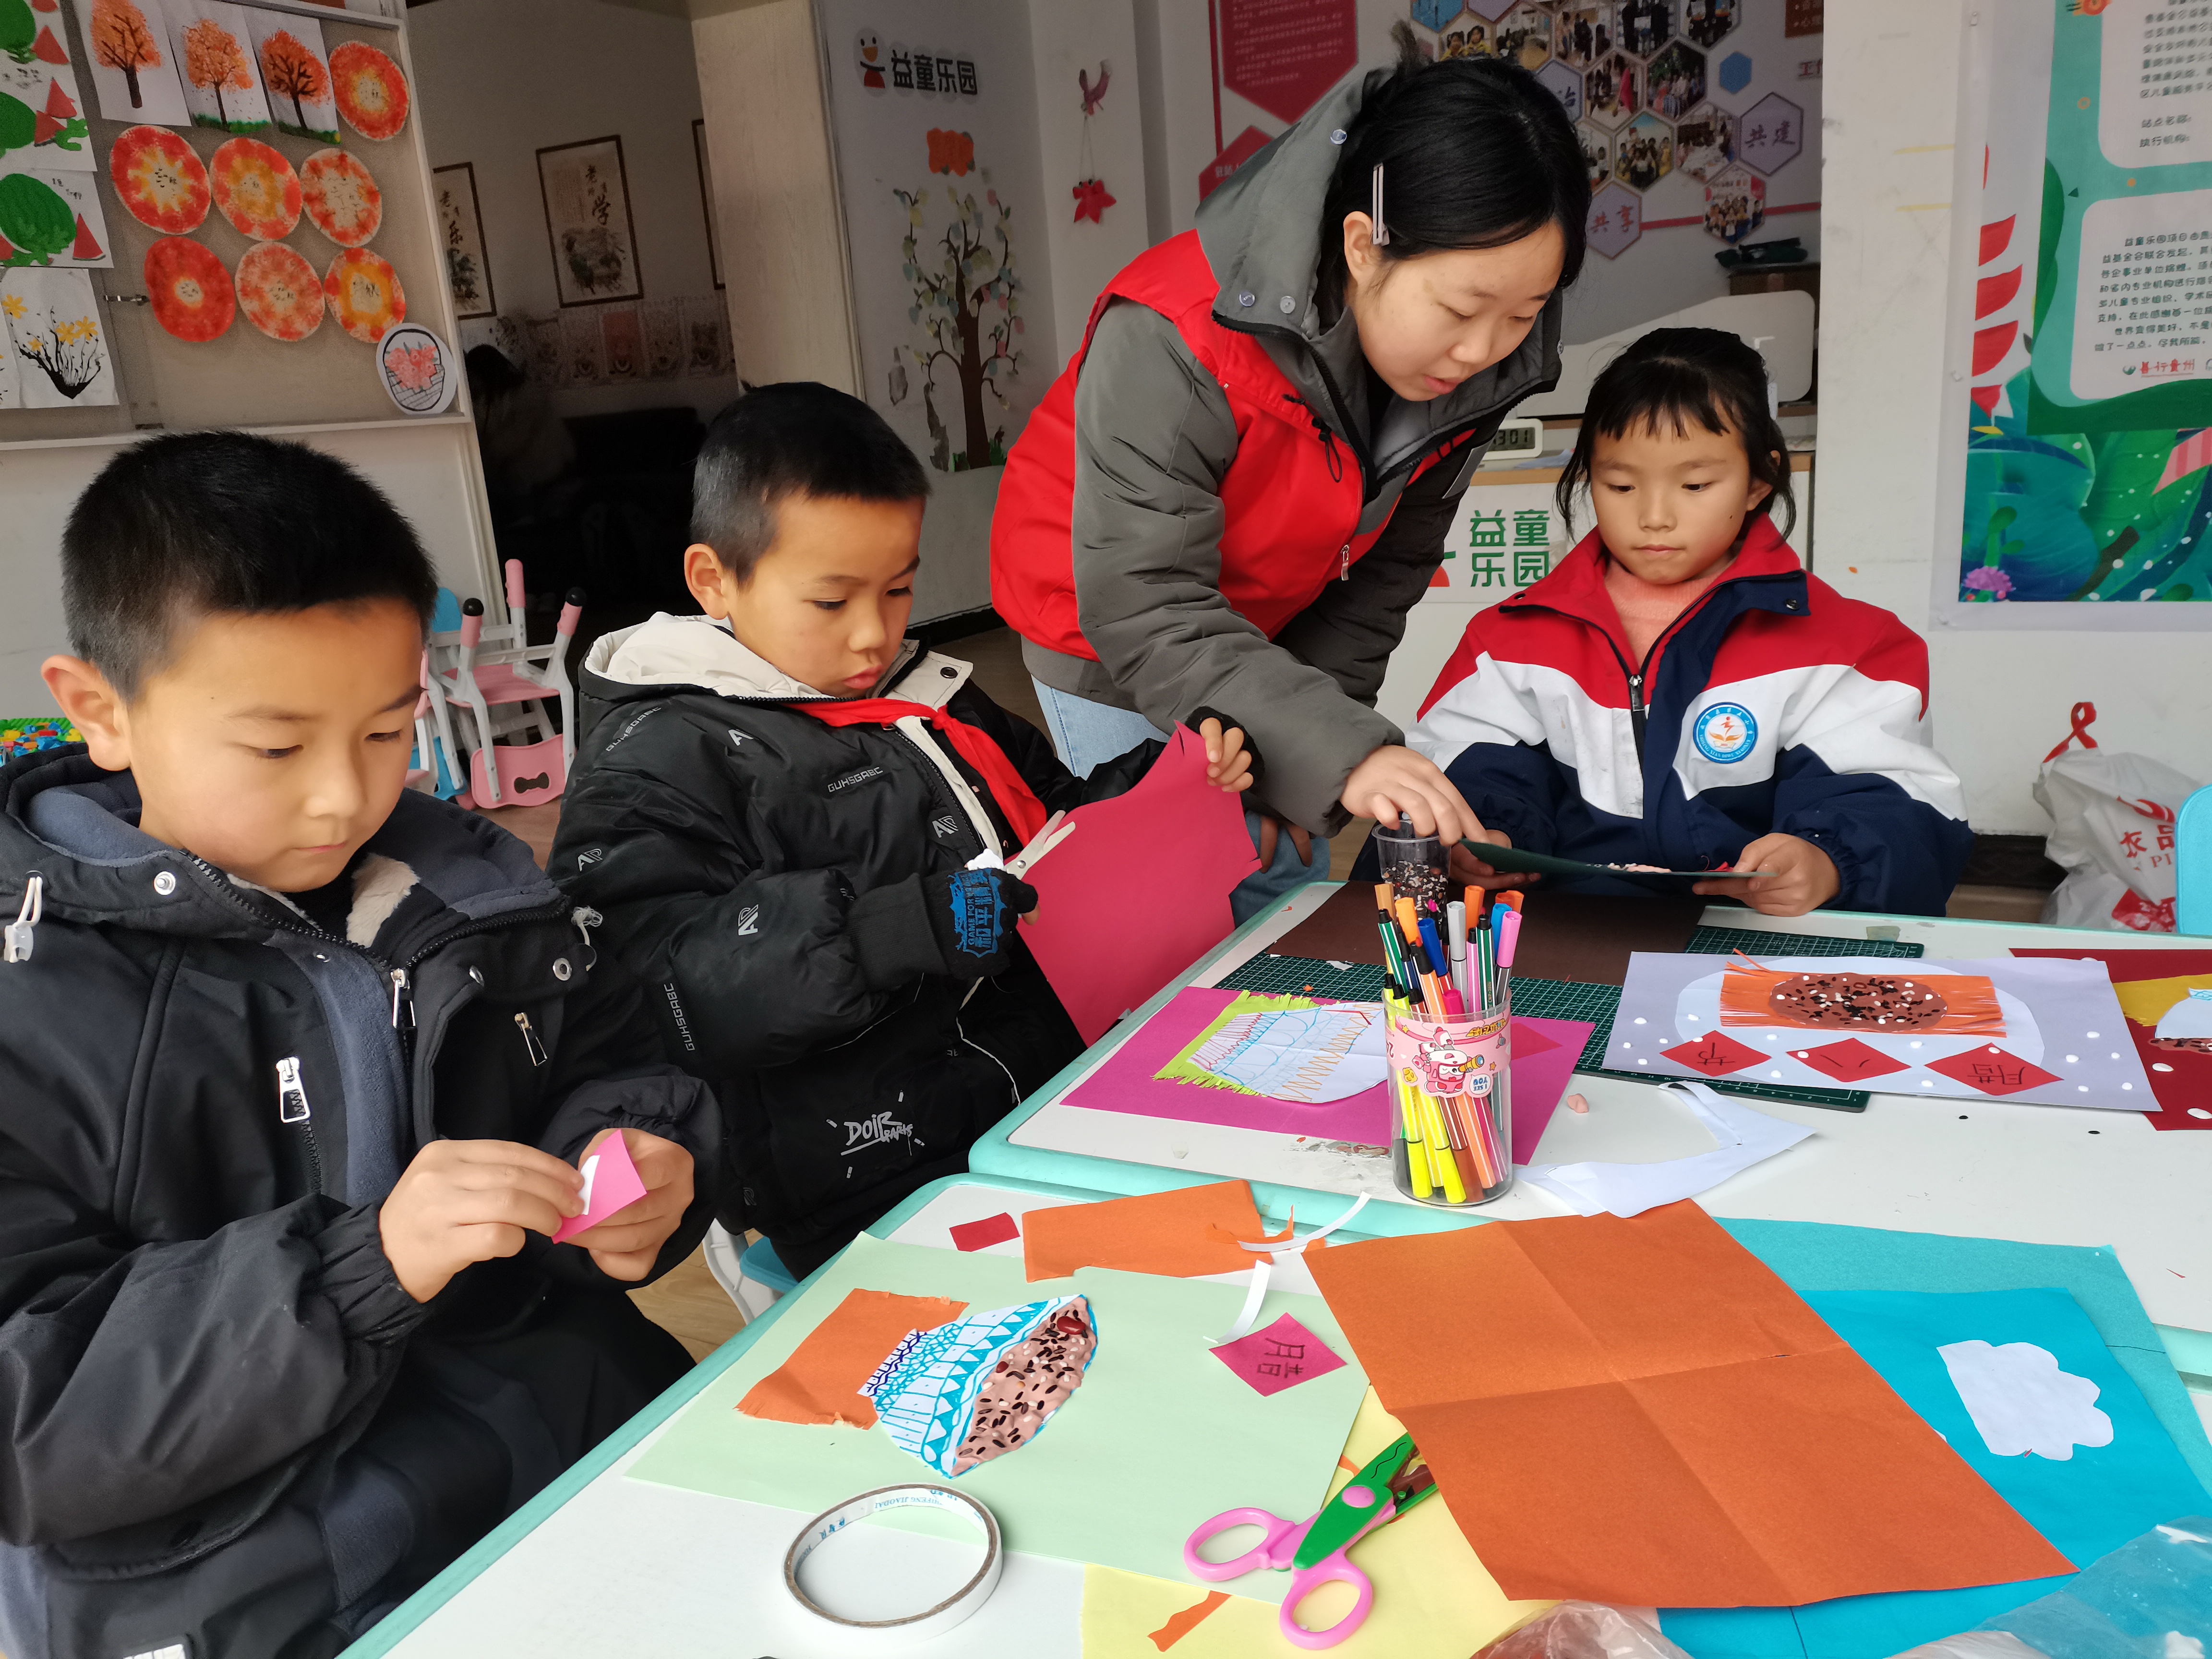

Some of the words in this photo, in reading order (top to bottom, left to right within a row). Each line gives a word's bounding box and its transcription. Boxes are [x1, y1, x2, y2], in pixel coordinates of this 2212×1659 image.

[891, 49, 978, 96] 益童乐园
[1745, 120, 1796, 148] 共建
[1590, 205, 1634, 233] 共享
[1470, 509, 1550, 547] 益童
[1470, 552, 1550, 587] 乐园
[827, 767, 884, 793] GUHSGABC
[2120, 825, 2175, 858] 衣品
[967, 898, 975, 916] FOR
[664, 983, 695, 1051] GUHSGABC
[1473, 1077, 1488, 1086] YOU
[1256, 1337, 1306, 1379] 腊
